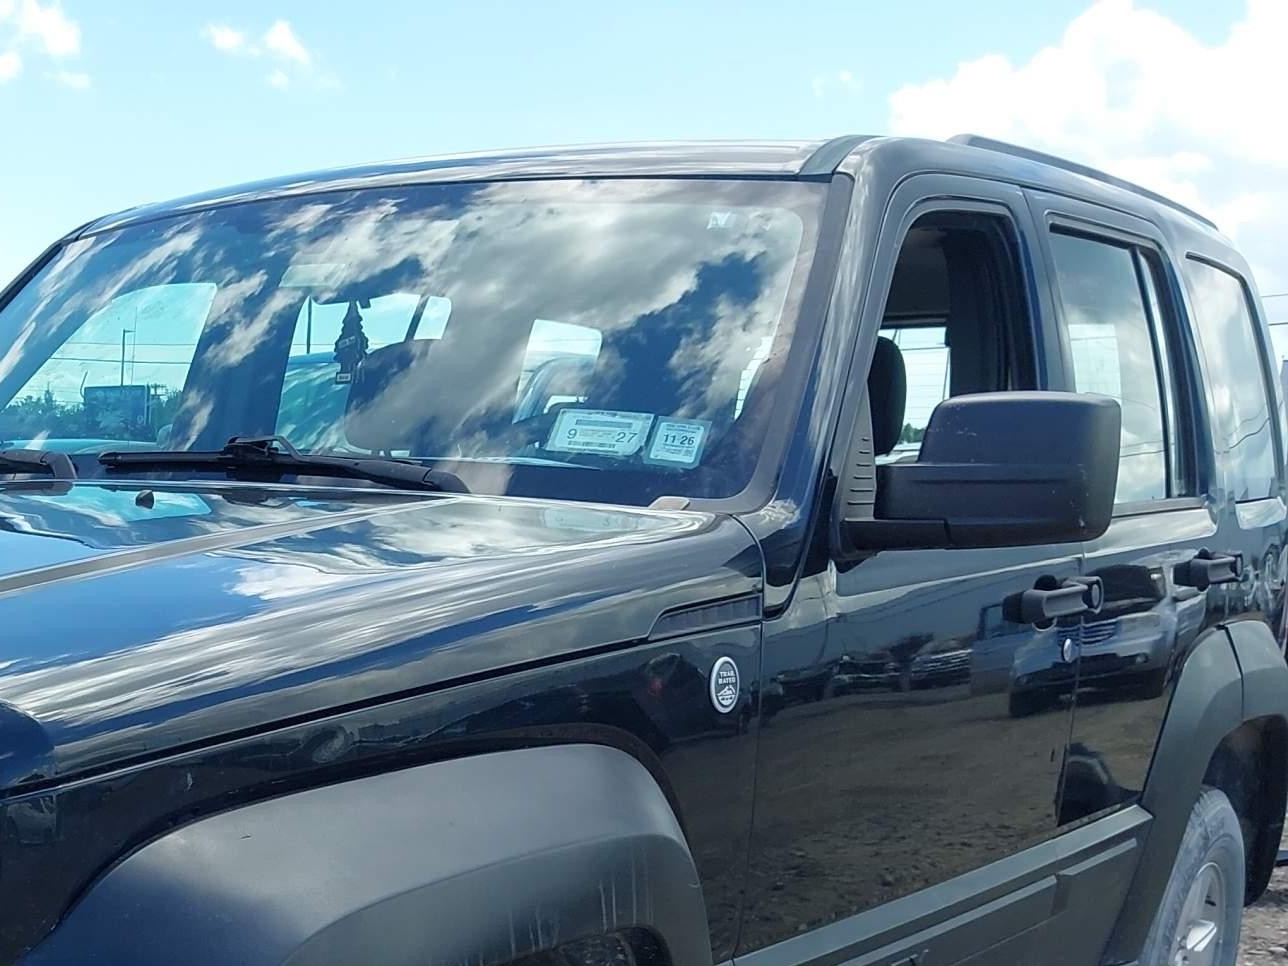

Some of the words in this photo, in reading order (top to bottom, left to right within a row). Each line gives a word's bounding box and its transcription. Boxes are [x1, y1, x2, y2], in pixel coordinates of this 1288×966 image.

[566, 428, 577, 440] 9
[615, 431, 638, 444] 27
[663, 433, 676, 444] 11
